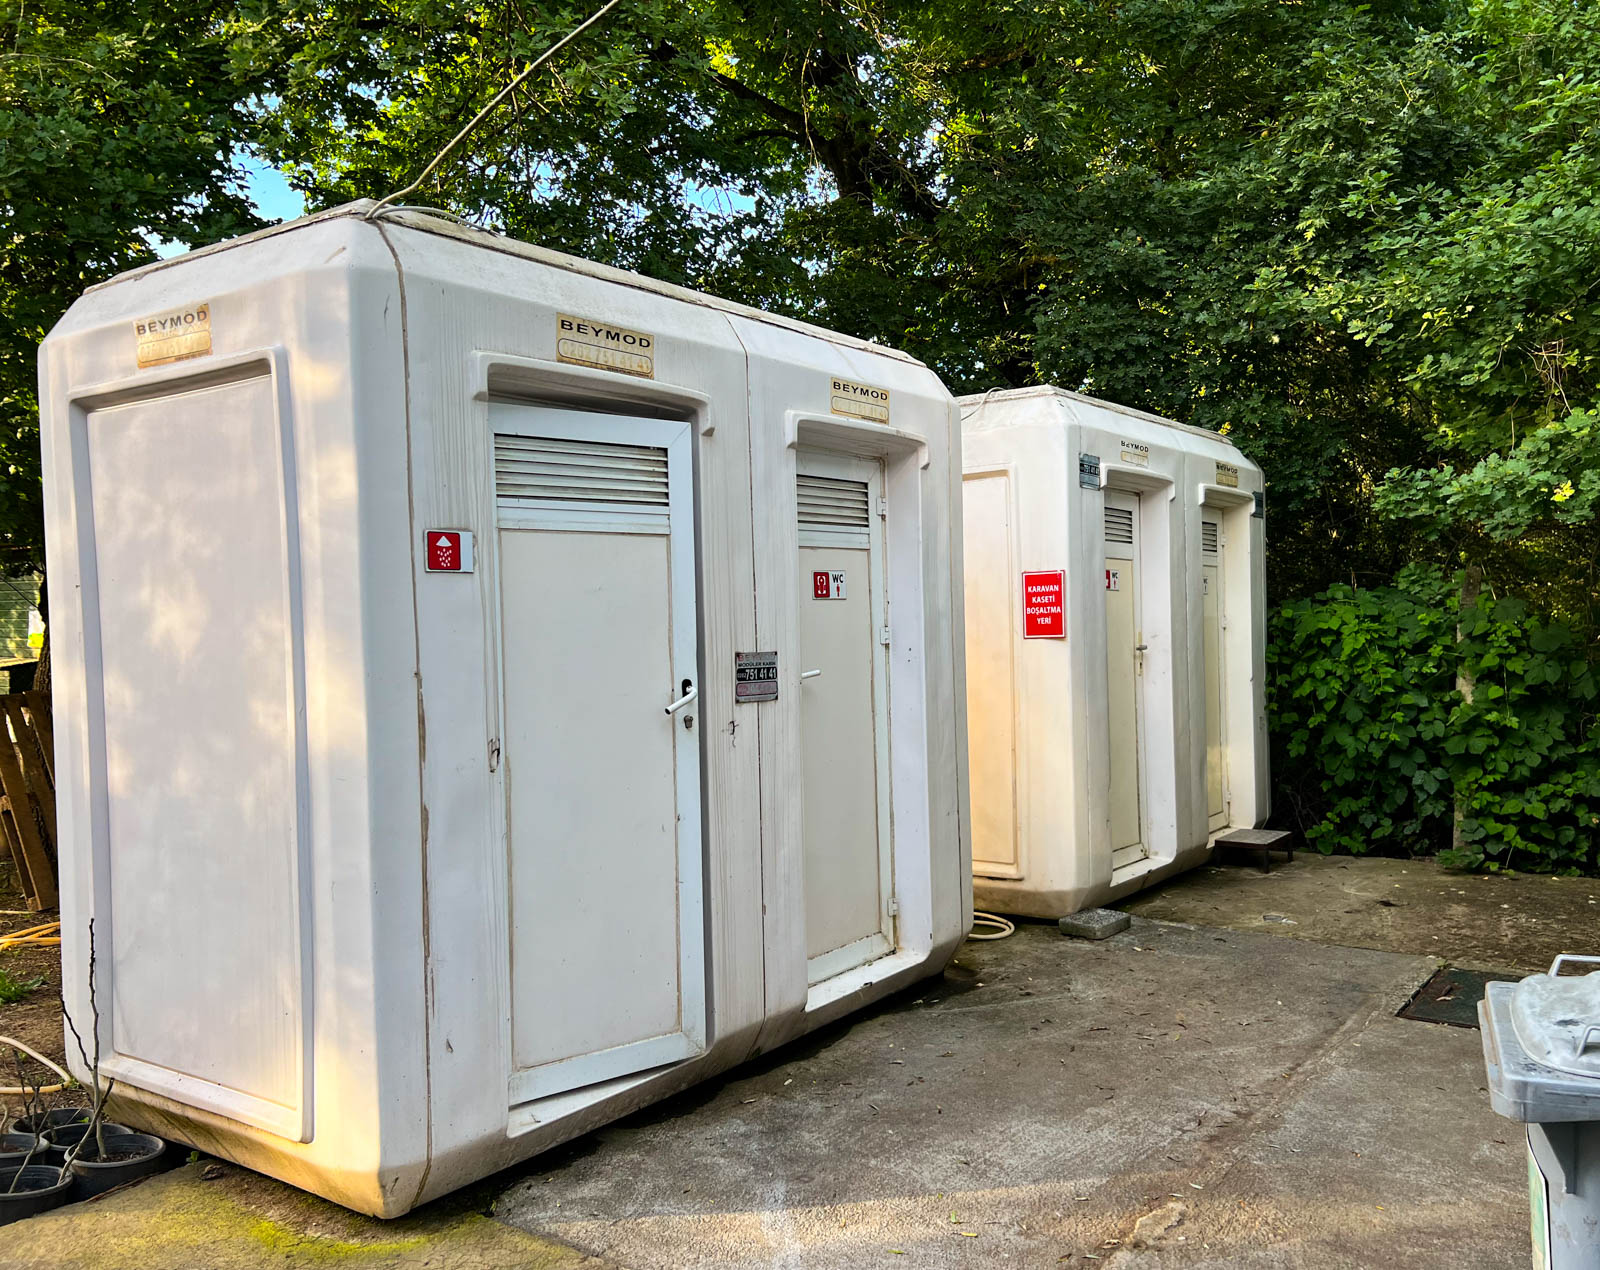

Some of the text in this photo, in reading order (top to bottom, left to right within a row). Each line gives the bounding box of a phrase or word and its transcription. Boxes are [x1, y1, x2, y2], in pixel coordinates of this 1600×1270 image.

[137, 310, 207, 335] BEYMOD
[561, 319, 651, 348] BEYMOD
[833, 381, 888, 401] BEYMOD
[832, 574, 844, 583] WC
[1027, 584, 1059, 593] KARAVAN
[1031, 593, 1055, 604] KASETİ
[1026, 606, 1061, 616] BOŞALTMA
[1036, 616, 1052, 625] YERİ
[746, 668, 758, 680] 751
[759, 668, 767, 679] 41
[769, 667, 777, 679] 41
